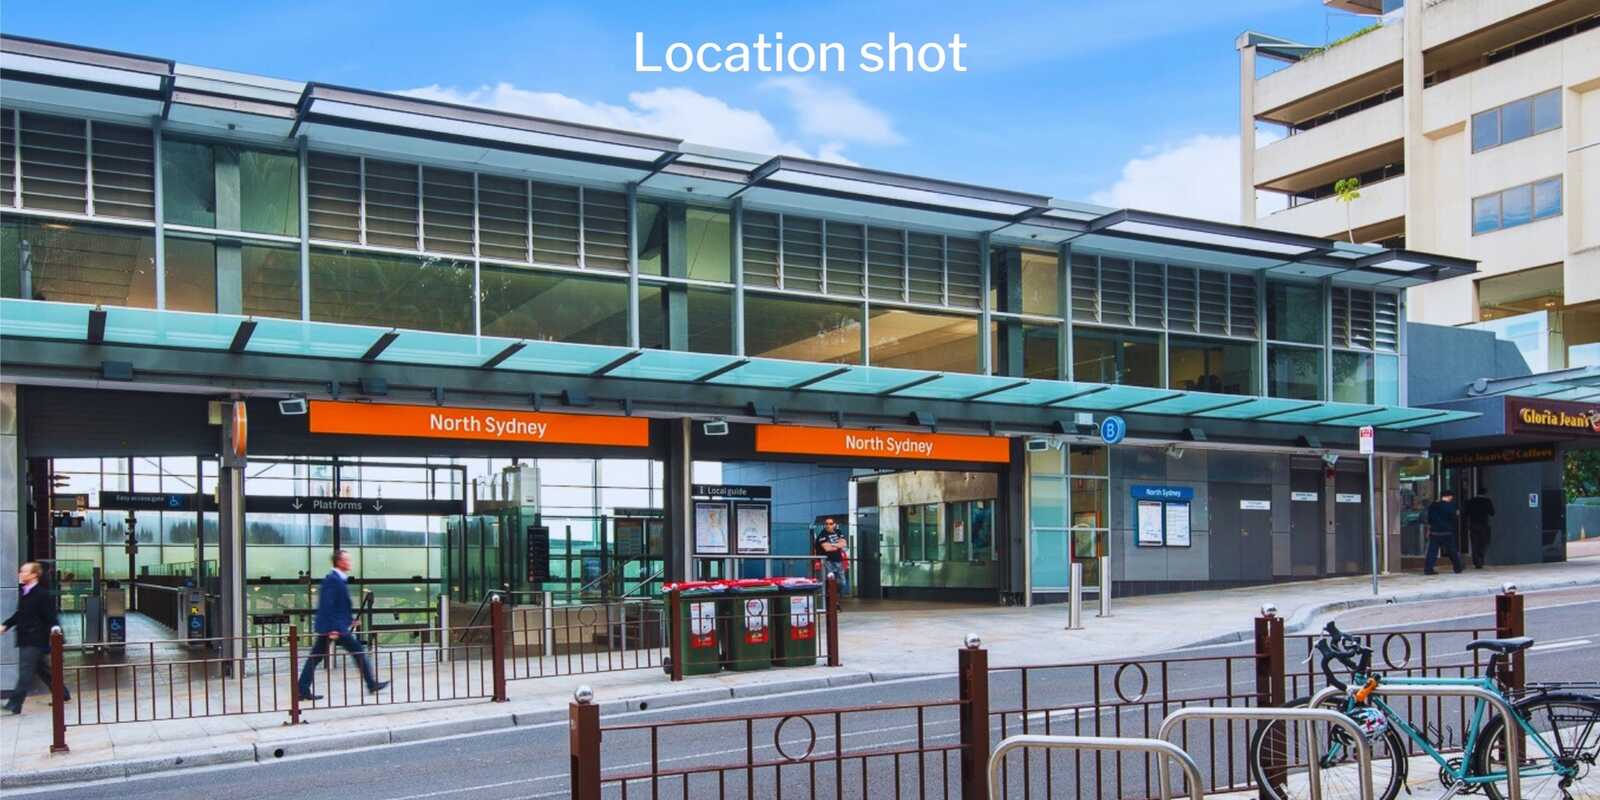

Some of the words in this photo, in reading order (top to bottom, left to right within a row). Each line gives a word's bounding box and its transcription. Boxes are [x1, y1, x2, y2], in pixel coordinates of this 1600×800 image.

[1521, 407, 1558, 425] Gloria
[1559, 411, 1589, 428] Jean's
[430, 413, 480, 432] North
[485, 416, 547, 439] Sydney
[845, 435, 883, 451] North
[886, 437, 933, 456] Sydney
[707, 487, 726, 495] Local
[727, 488, 747, 496] guide
[1145, 488, 1162, 496] North
[1162, 489, 1181, 497] Sydney
[313, 500, 362, 510] Platforms
